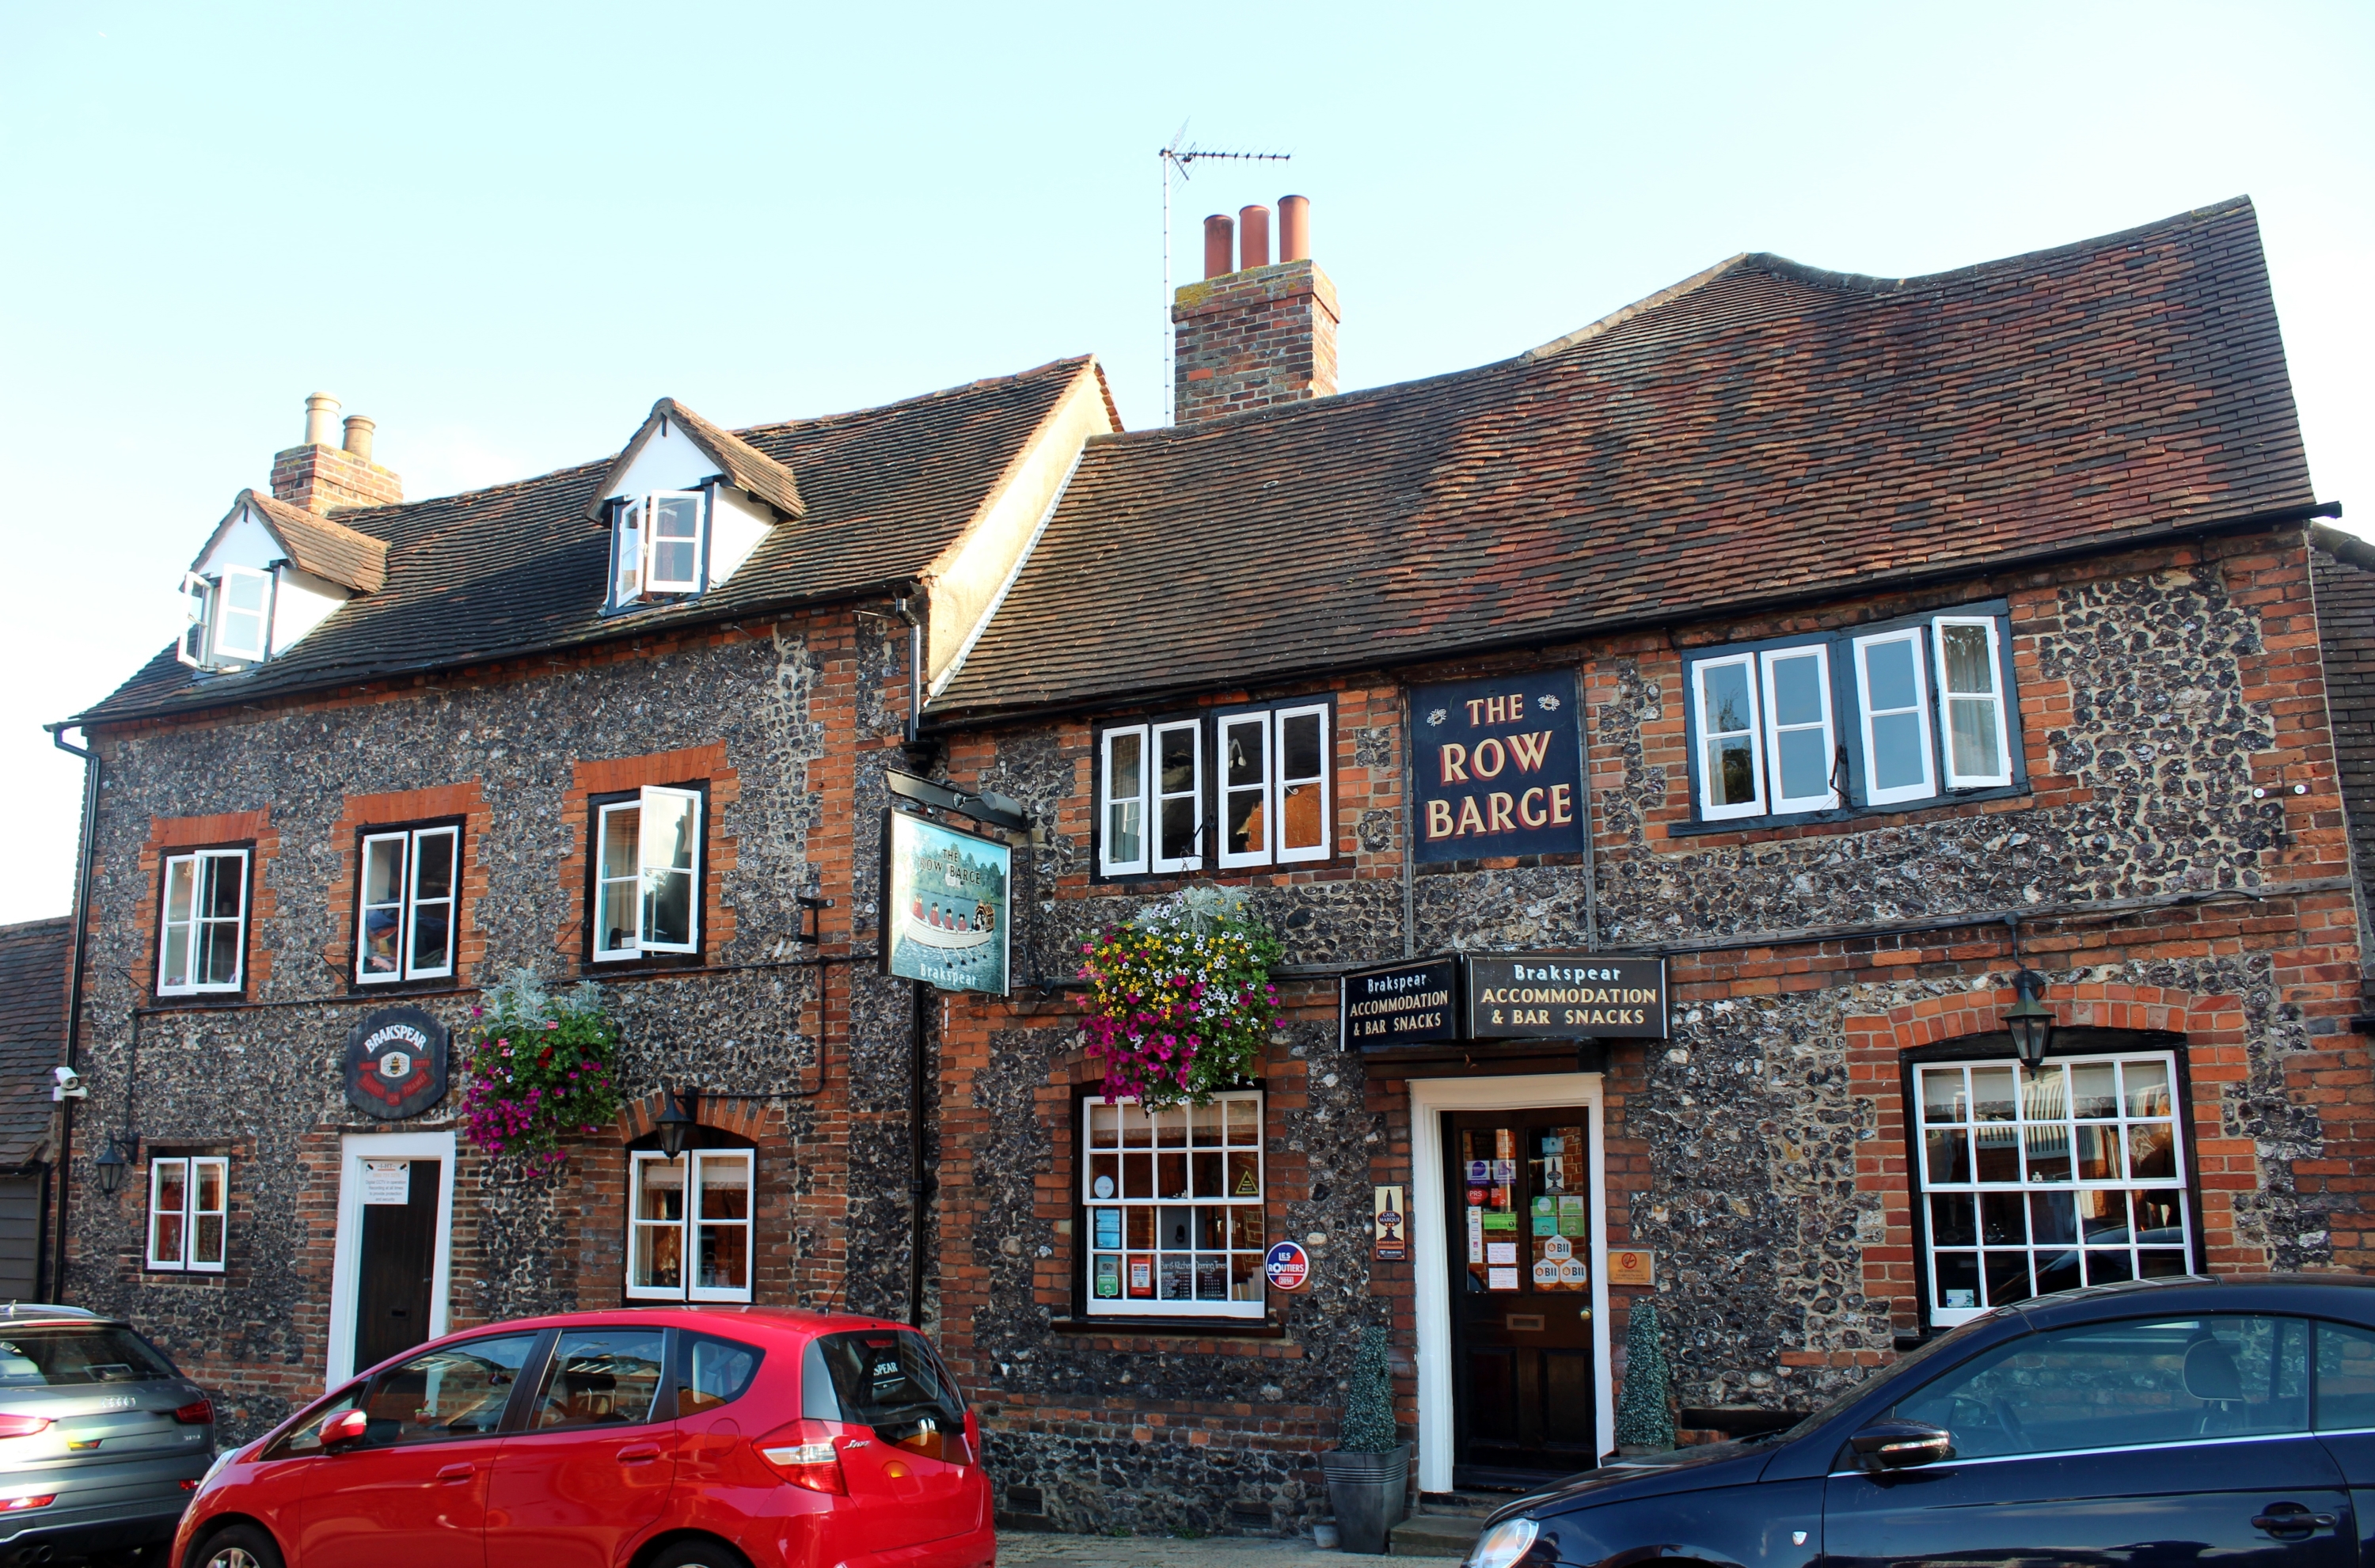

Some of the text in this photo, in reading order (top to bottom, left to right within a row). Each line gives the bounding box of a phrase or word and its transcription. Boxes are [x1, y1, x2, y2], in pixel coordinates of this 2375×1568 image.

[1466, 693, 1523, 726] THE
[1441, 731, 1552, 783] ROW
[1427, 784, 1572, 840] BARGE
[920, 858, 943, 872] ROW
[943, 849, 958, 862] THE
[921, 963, 976, 987] Brakspear
[1368, 974, 1427, 993] Brakspear
[1514, 964, 1621, 985] Brakspear
[1350, 990, 1448, 1016] ACCOMMODATION
[1480, 989, 1656, 1004] ACCOMMODATION
[1354, 1012, 1441, 1036] & BAR SNACKS
[1492, 1009, 1644, 1024] & BAR SNACKS
[364, 1024, 428, 1054] BRAKSPEAR
[1279, 1252, 1290, 1261] LES
[1557, 1243, 1568, 1252] BII
[1268, 1262, 1304, 1273] ROUTIERS
[1572, 1267, 1583, 1276] BII
